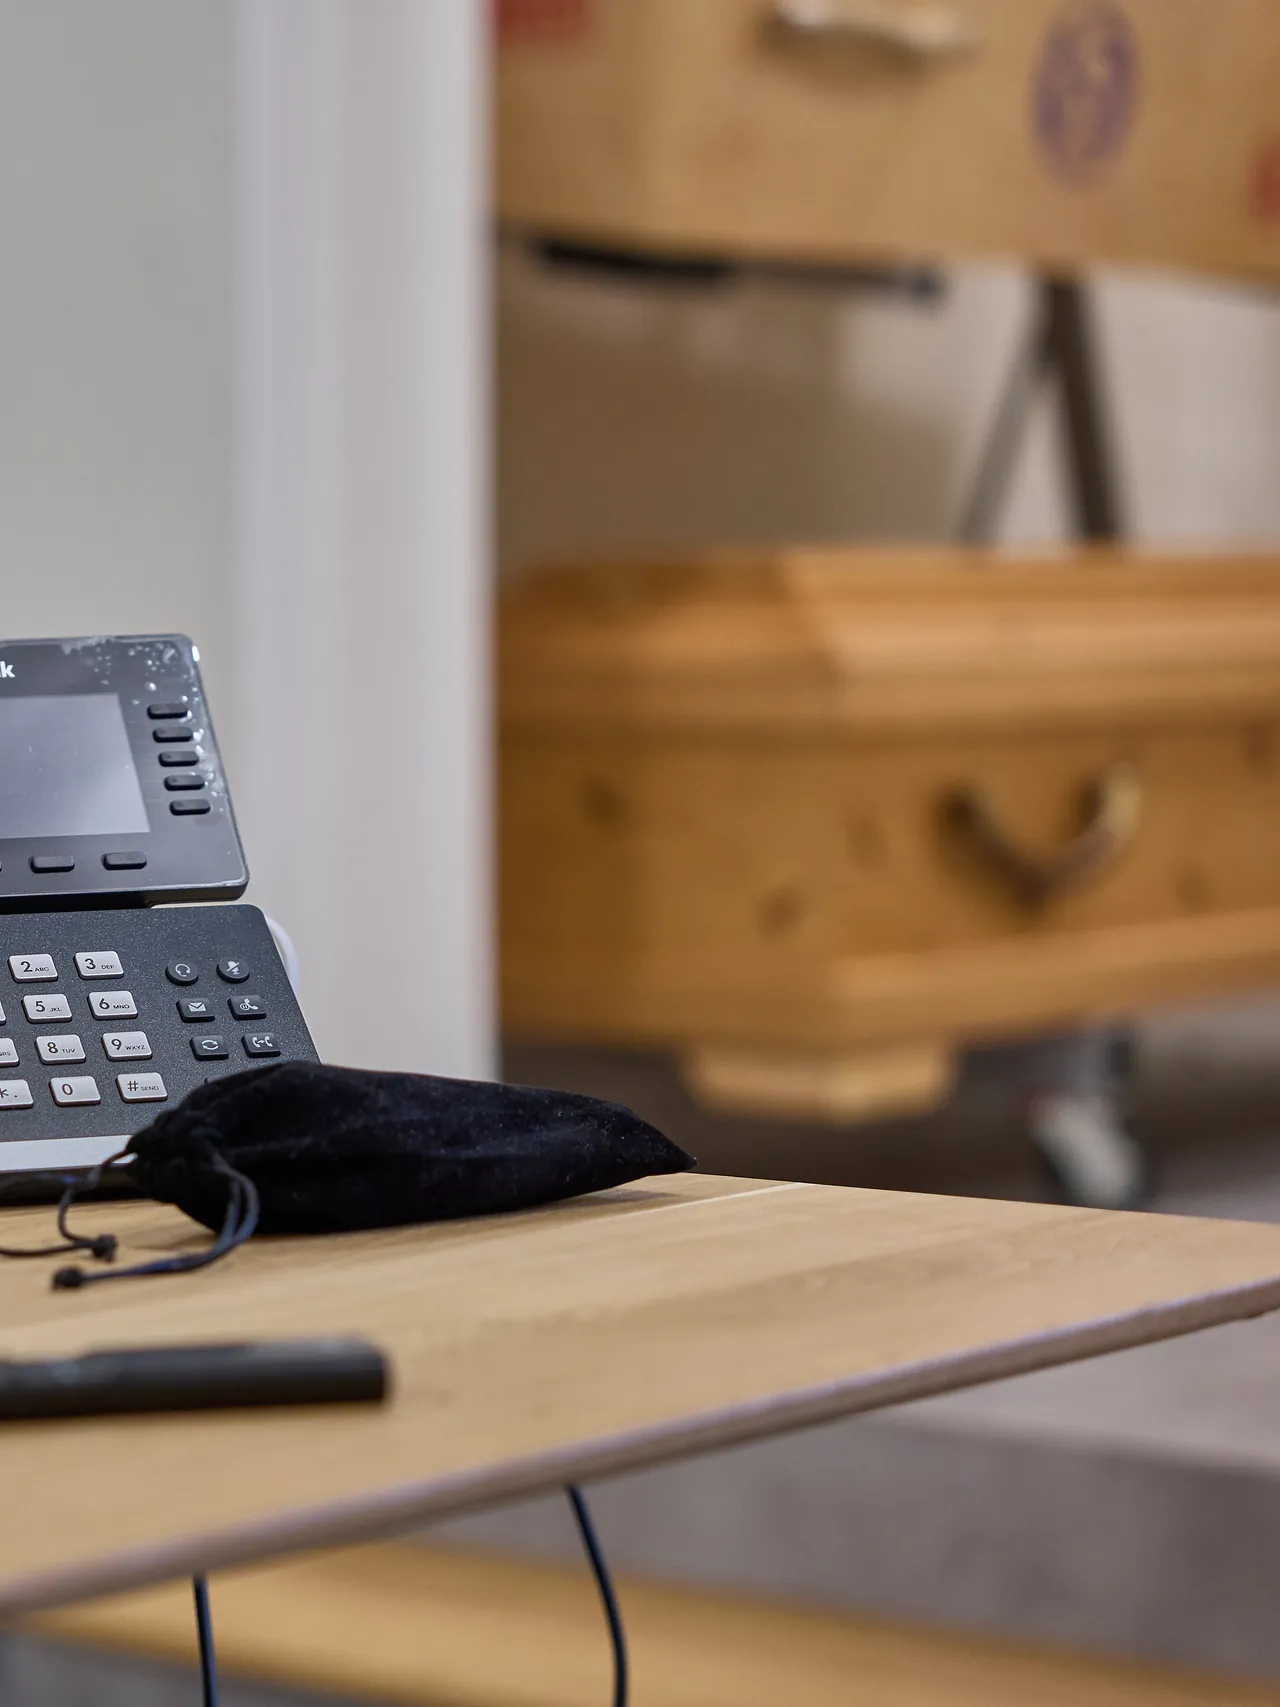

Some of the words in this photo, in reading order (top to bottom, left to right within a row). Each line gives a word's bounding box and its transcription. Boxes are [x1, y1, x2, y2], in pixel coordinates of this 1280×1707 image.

[20, 961, 33, 973] 2
[84, 958, 96, 970] 3
[35, 1000, 46, 1013] 5
[99, 998, 110, 1010] 6
[47, 1041, 59, 1054] 8
[111, 1038, 122, 1051] 9
[61, 1083, 73, 1096] 0
